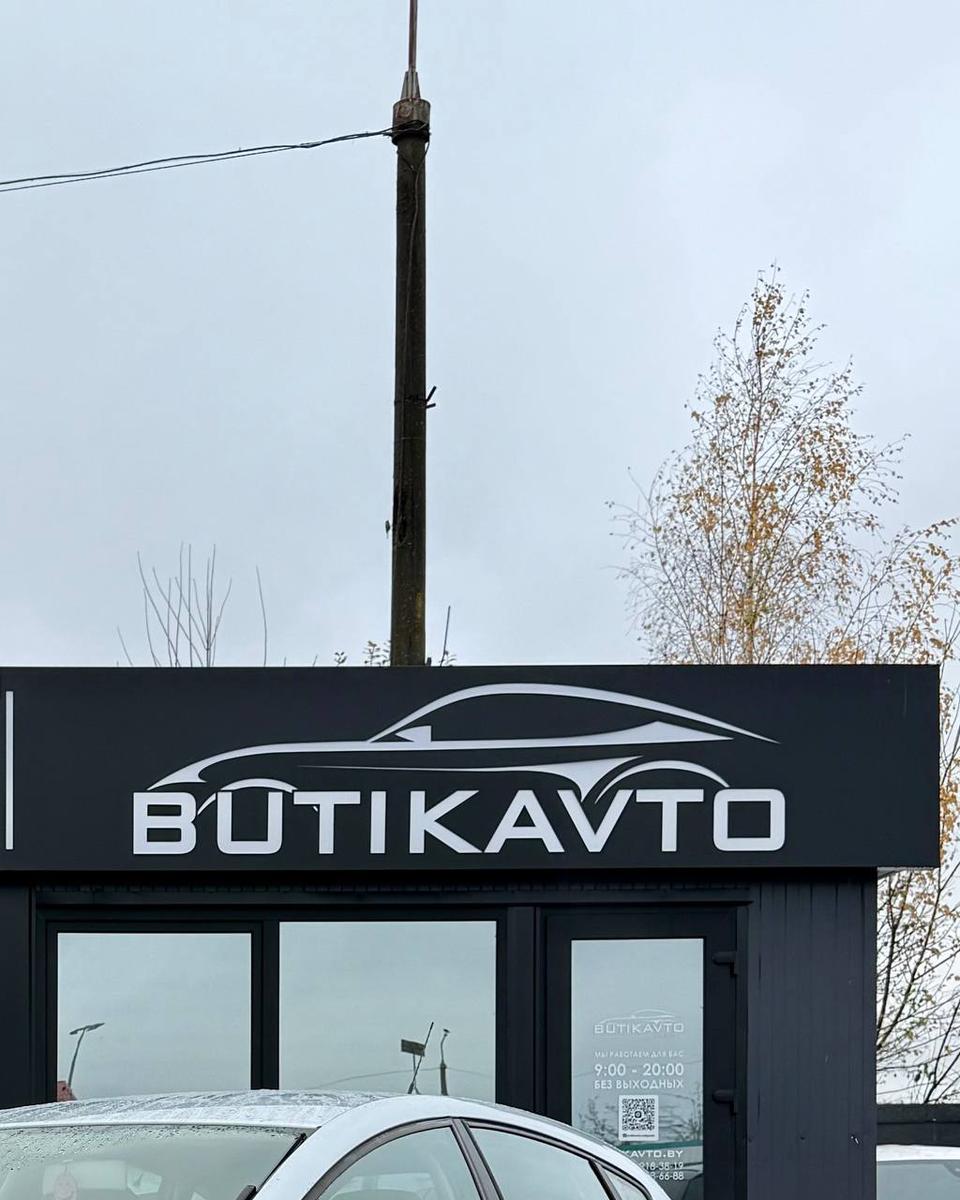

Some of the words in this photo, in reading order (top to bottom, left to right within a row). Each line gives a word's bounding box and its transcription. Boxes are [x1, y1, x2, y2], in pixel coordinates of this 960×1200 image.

[132, 788, 786, 856] BUTIKAVTO
[594, 1023, 684, 1034] BUTIKAVTO
[594, 1064, 626, 1076] 9:00
[642, 1064, 685, 1076] 20:00
[594, 1079, 612, 1090] БЕЗ
[616, 1079, 684, 1089] ВЫХОДНЫХ
